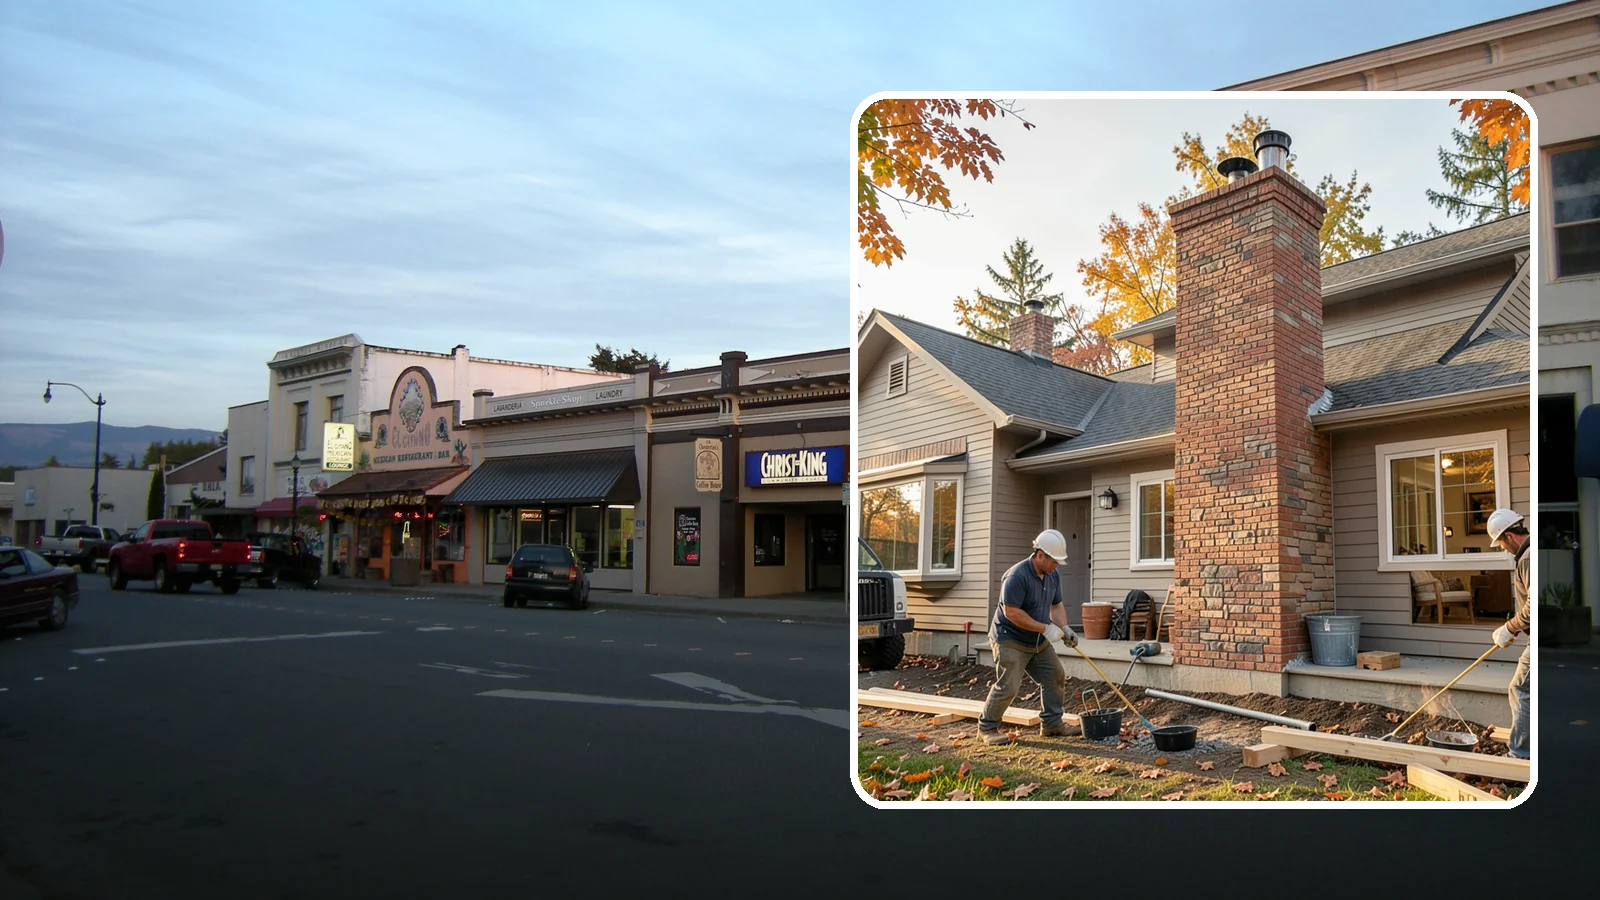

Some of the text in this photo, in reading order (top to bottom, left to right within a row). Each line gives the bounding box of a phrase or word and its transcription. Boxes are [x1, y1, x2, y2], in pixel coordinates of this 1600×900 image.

[531, 394, 582, 409] Sparkle Shop
[596, 389, 623, 400] LAUNDRY
[494, 402, 522, 412] LAVANDERIA
[374, 450, 450, 464] MEXICAN RESTAURANT BAR
[761, 450, 826, 478] CHRIST KING
